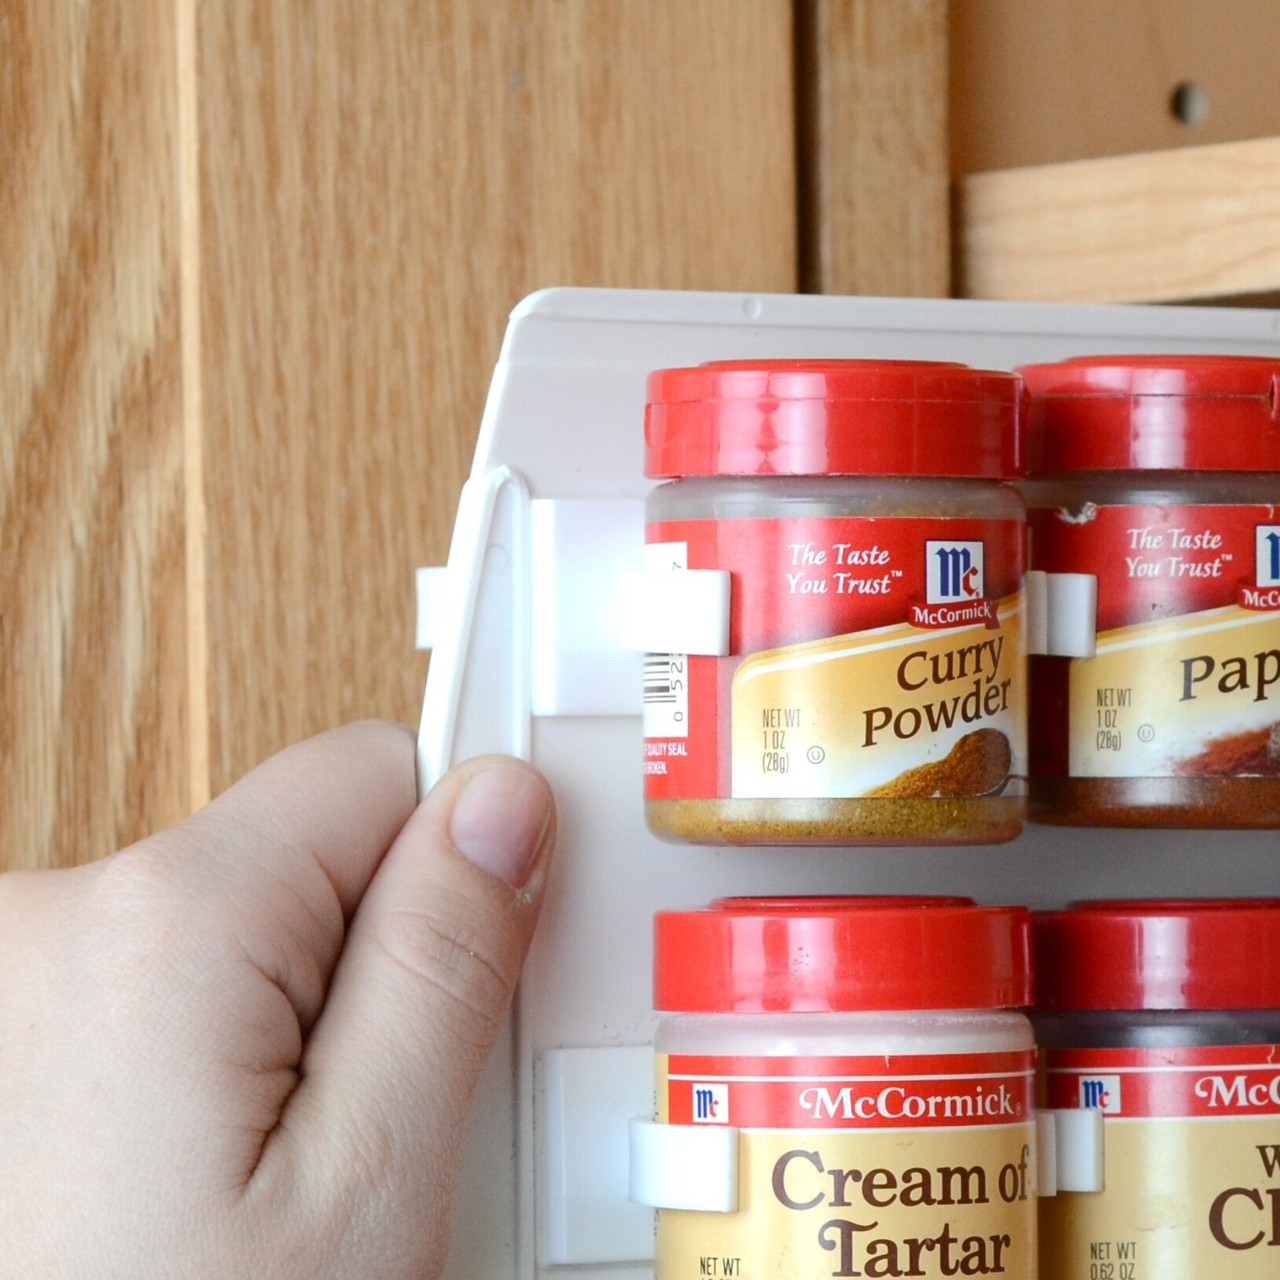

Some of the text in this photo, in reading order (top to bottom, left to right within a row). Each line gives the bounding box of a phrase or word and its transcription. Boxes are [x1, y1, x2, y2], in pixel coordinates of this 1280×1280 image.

[1127, 526, 1223, 550] The Taste
[787, 542, 890, 566] The Taste
[1125, 556, 1160, 578] You
[786, 573, 828, 595] You
[912, 600, 993, 626] McCormick
[896, 635, 1005, 692] Curry
[1096, 688, 1133, 707] NET WT
[763, 709, 801, 728] NET WT
[861, 677, 1012, 749] Powder
[1096, 709, 1118, 728] 1 OZ
[668, 741, 689, 757] SEAL
[763, 731, 786, 750] 1 OZ
[1096, 731, 1123, 752] (28g)
[762, 752, 790, 774] (28g)
[771, 1143, 1030, 1211] Cream of
[817, 1218, 1012, 1279] Tartar
[1090, 1242, 1137, 1260] NET WT
[700, 1256, 741, 1276] NET WT
[1090, 1263, 1136, 1280] 0.62 OZ
